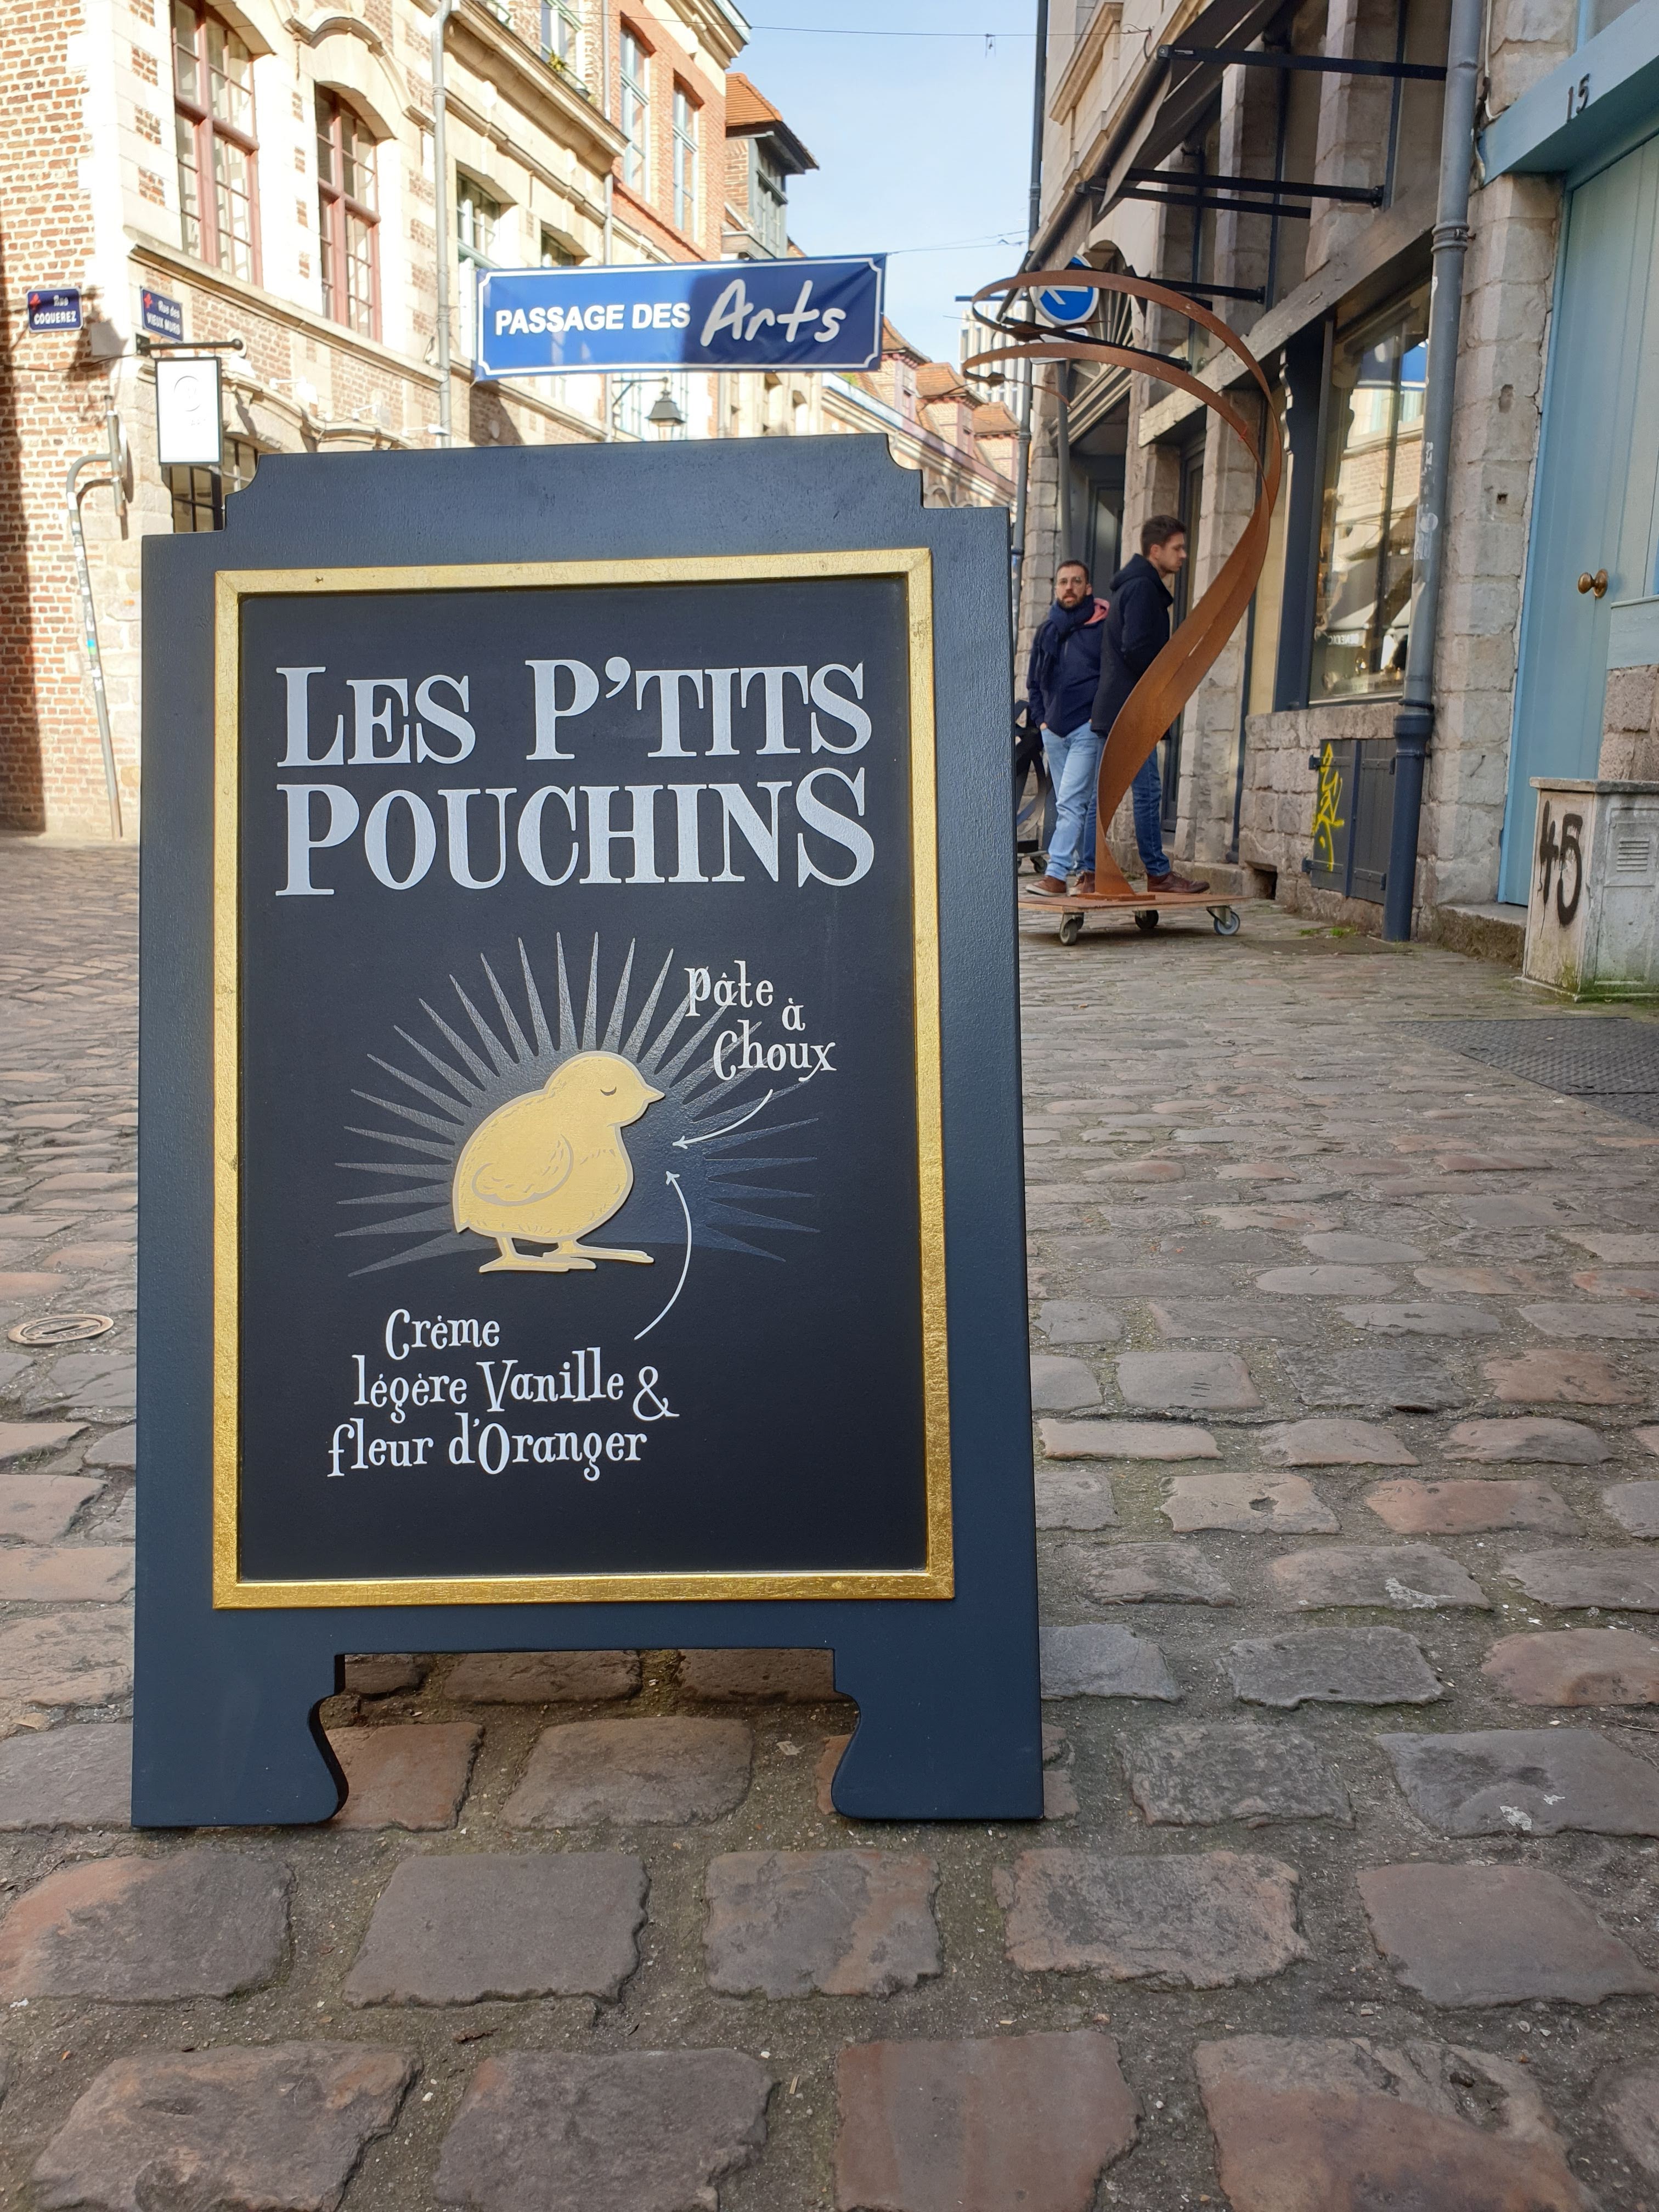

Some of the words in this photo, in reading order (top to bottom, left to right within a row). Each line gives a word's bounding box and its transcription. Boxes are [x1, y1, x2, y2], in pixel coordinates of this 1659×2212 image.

[1567, 73, 1590, 123] 15
[33, 311, 77, 325] COQUEREZ
[53, 295, 69, 307] Rue
[158, 300, 170, 315] Rue
[496, 304, 625, 336] PASSAGE
[633, 303, 691, 329] DES
[700, 279, 847, 347] Arts
[276, 667, 475, 766] LES
[275, 767, 874, 896] POUCHINS
[782, 997, 805, 1031] à
[713, 1019, 837, 1082] Choux
[385, 1308, 500, 1360] Crème
[352, 1355, 467, 1423] légère
[476, 1347, 623, 1412] Vanille
[633, 1366, 679, 1420] &
[328, 1417, 433, 1477] fleur
